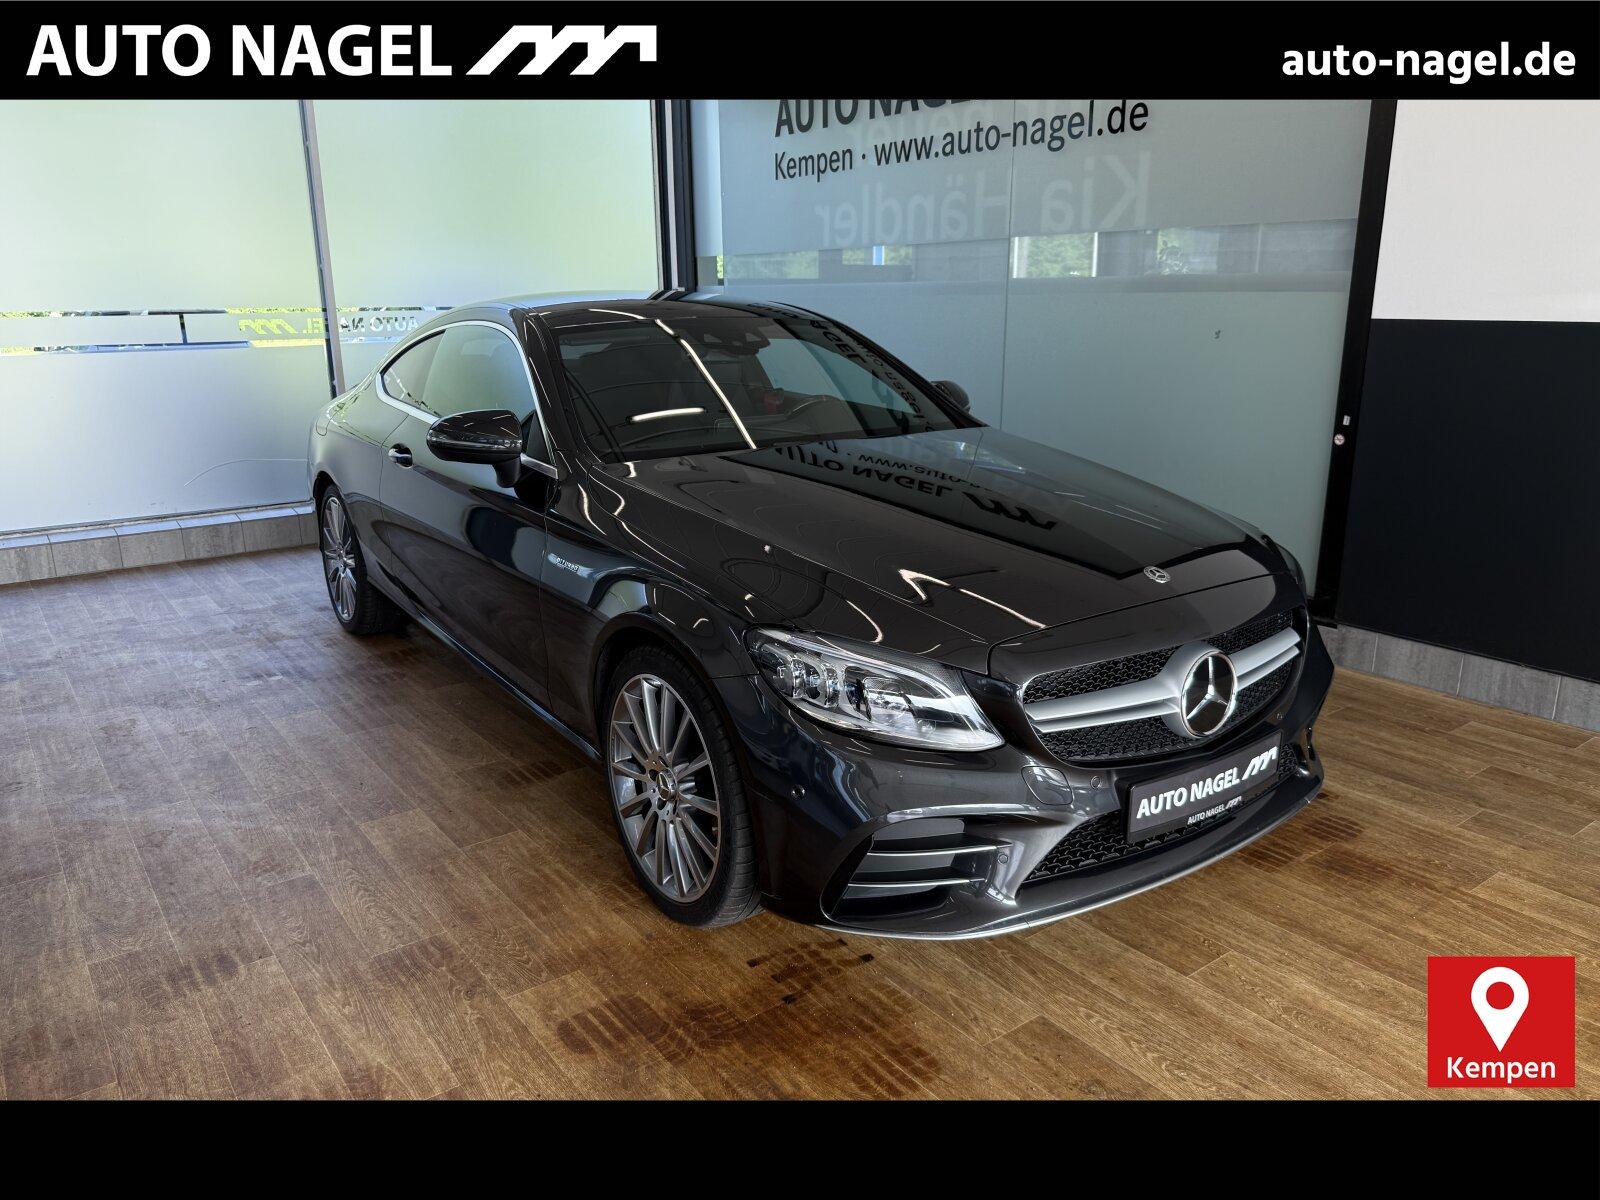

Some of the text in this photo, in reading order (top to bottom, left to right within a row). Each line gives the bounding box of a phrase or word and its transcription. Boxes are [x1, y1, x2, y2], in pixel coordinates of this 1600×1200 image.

[775, 151, 854, 183] Kempen
[874, 99, 1149, 166] www.auto-nagel.de
[1136, 767, 1240, 819] AUTO NAGEL
[1187, 803, 1226, 825] AUTO NAGEL
